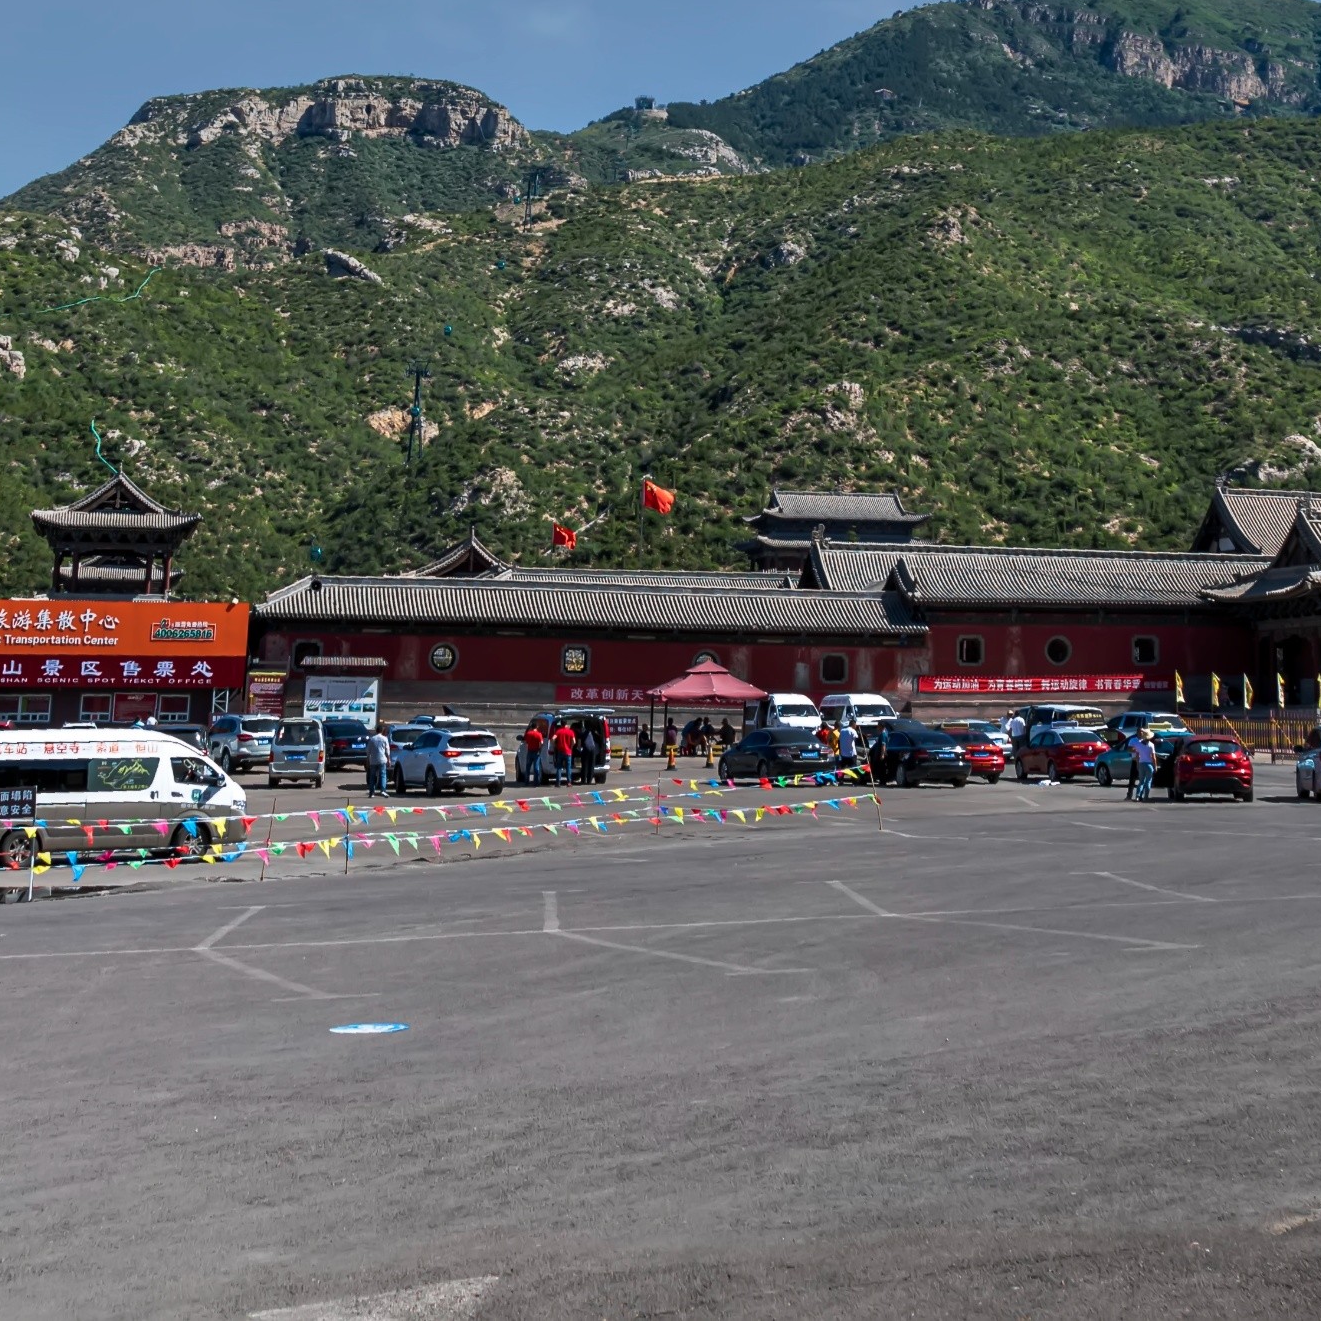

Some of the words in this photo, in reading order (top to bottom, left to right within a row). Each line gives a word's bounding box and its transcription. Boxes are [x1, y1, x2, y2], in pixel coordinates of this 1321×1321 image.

[5, 634, 81, 646] Transportation
[83, 635, 119, 645] Center
[571, 688, 644, 701] 改革创新天
